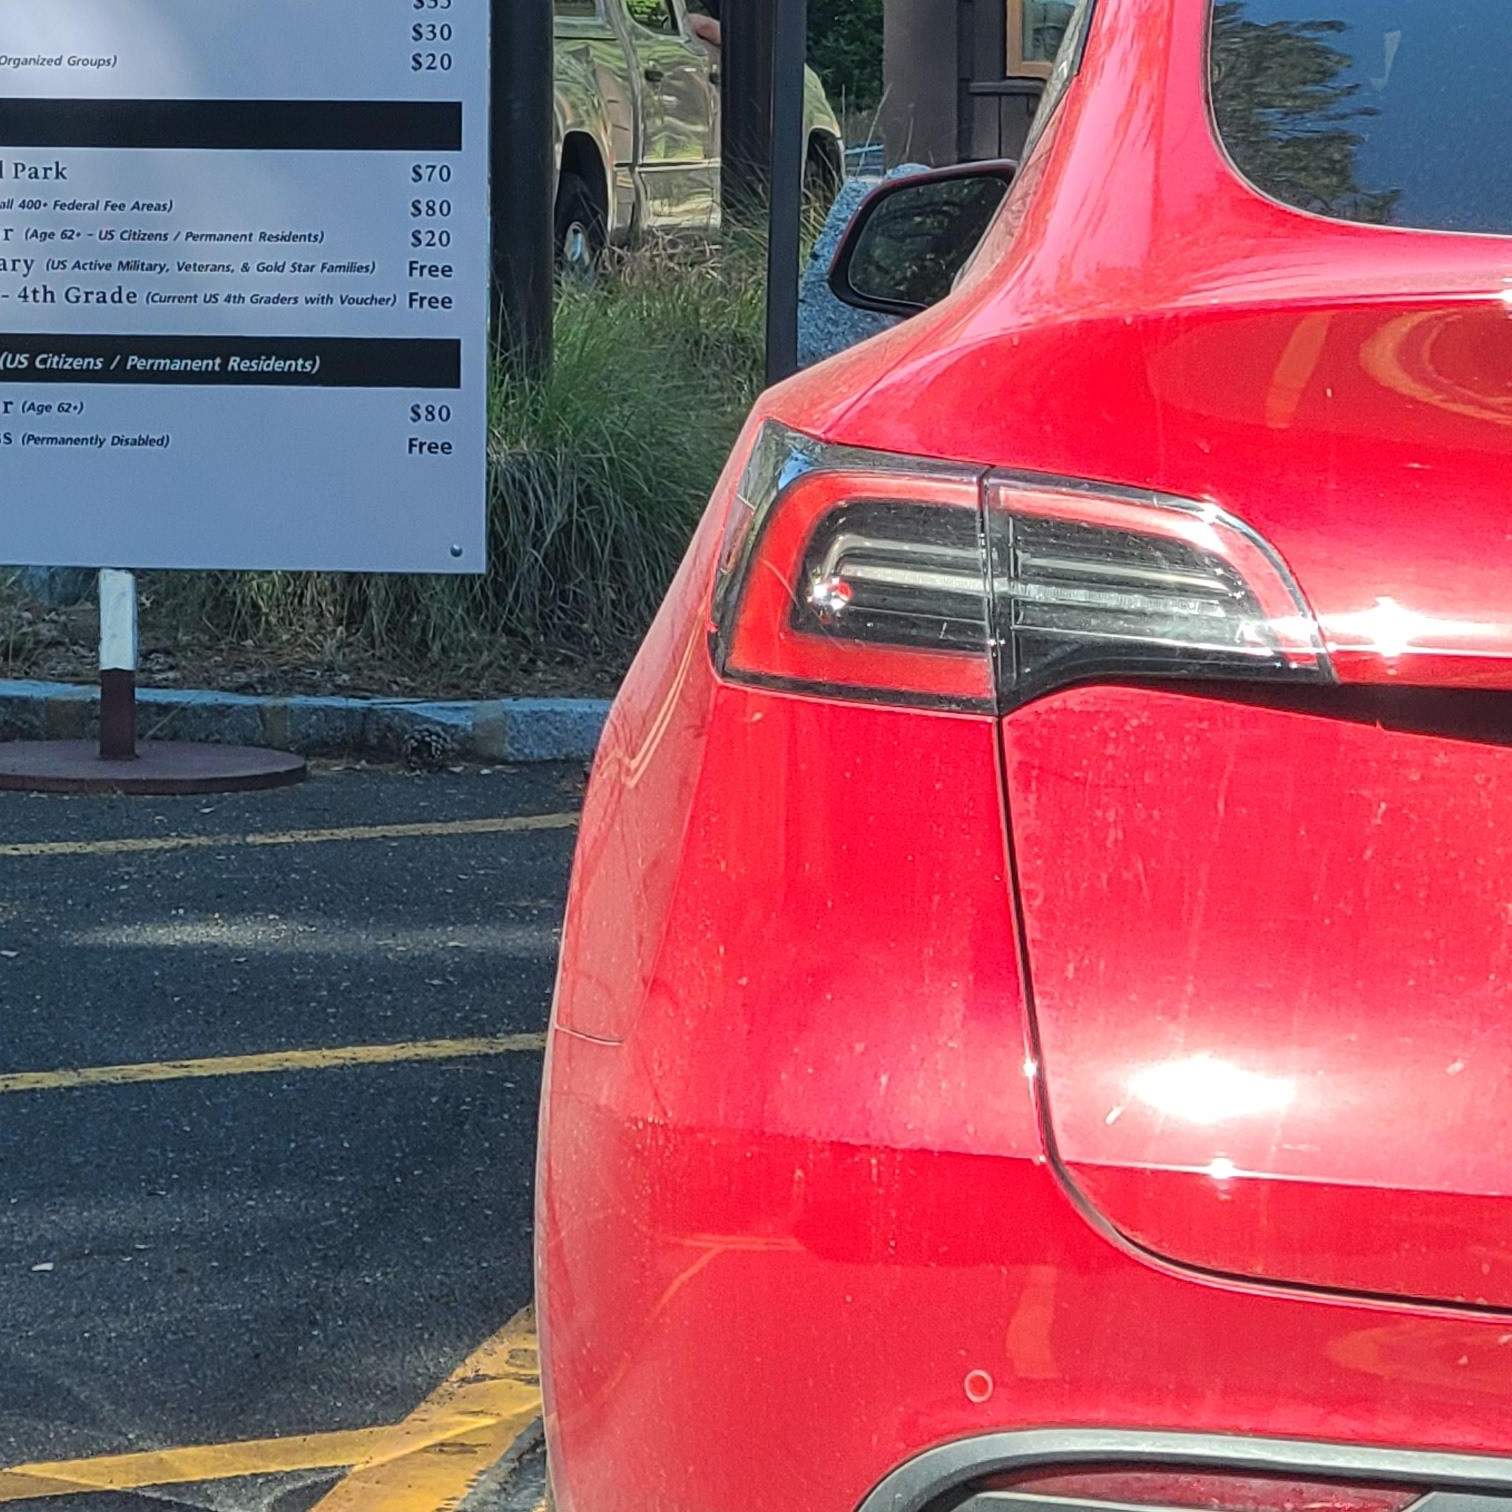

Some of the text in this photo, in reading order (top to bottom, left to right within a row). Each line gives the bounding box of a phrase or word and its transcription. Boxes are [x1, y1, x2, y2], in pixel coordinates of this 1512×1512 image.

[411, 23, 452, 42] $30
[67, 55, 118, 69] Groups)
[411, 53, 452, 72] $20
[12, 162, 68, 181] Park
[411, 164, 451, 183] $70
[0, 198, 13, 210] all
[18, 198, 48, 211] 400+
[53, 199, 99, 211] Federal
[104, 199, 126, 212] Fee
[131, 199, 173, 213] Areas)
[410, 198, 451, 218] $80
[25, 227, 55, 242] (Age
[98, 229, 115, 241] US
[120, 229, 168, 242] Citizens
[185, 231, 253, 243] Permanent
[258, 231, 325, 244] Residents)
[410, 229, 451, 248] $20
[46, 258, 67, 273] (US
[72, 259, 112, 272] Active
[117, 260, 170, 274] Military,
[176, 261, 235, 274] Veterans,
[241, 262, 250, 273] &
[256, 261, 285, 273] Gold
[290, 262, 316, 273] Star
[320, 261, 376, 275] Families)
[408, 260, 453, 278] Free
[17, 285, 55, 303] 4th
[65, 286, 137, 304] Grade
[146, 292, 198, 305] (Current
[203, 292, 219, 305] US
[224, 293, 245, 305] 4th
[250, 293, 299, 305] Graders
[305, 293, 334, 306] with
[339, 294, 397, 308] Voucher)
[408, 292, 453, 309] Free
[0, 352, 29, 370] (US
[35, 353, 104, 370] Citizens
[110, 355, 120, 370] /
[126, 355, 221, 372] Permanent
[228, 355, 321, 375] Residents)
[22, 401, 52, 416] (Age
[410, 403, 451, 423] $80
[22, 433, 106, 448] (Permanently
[110, 434, 170, 448] Disabled)
[408, 437, 453, 455] Free
